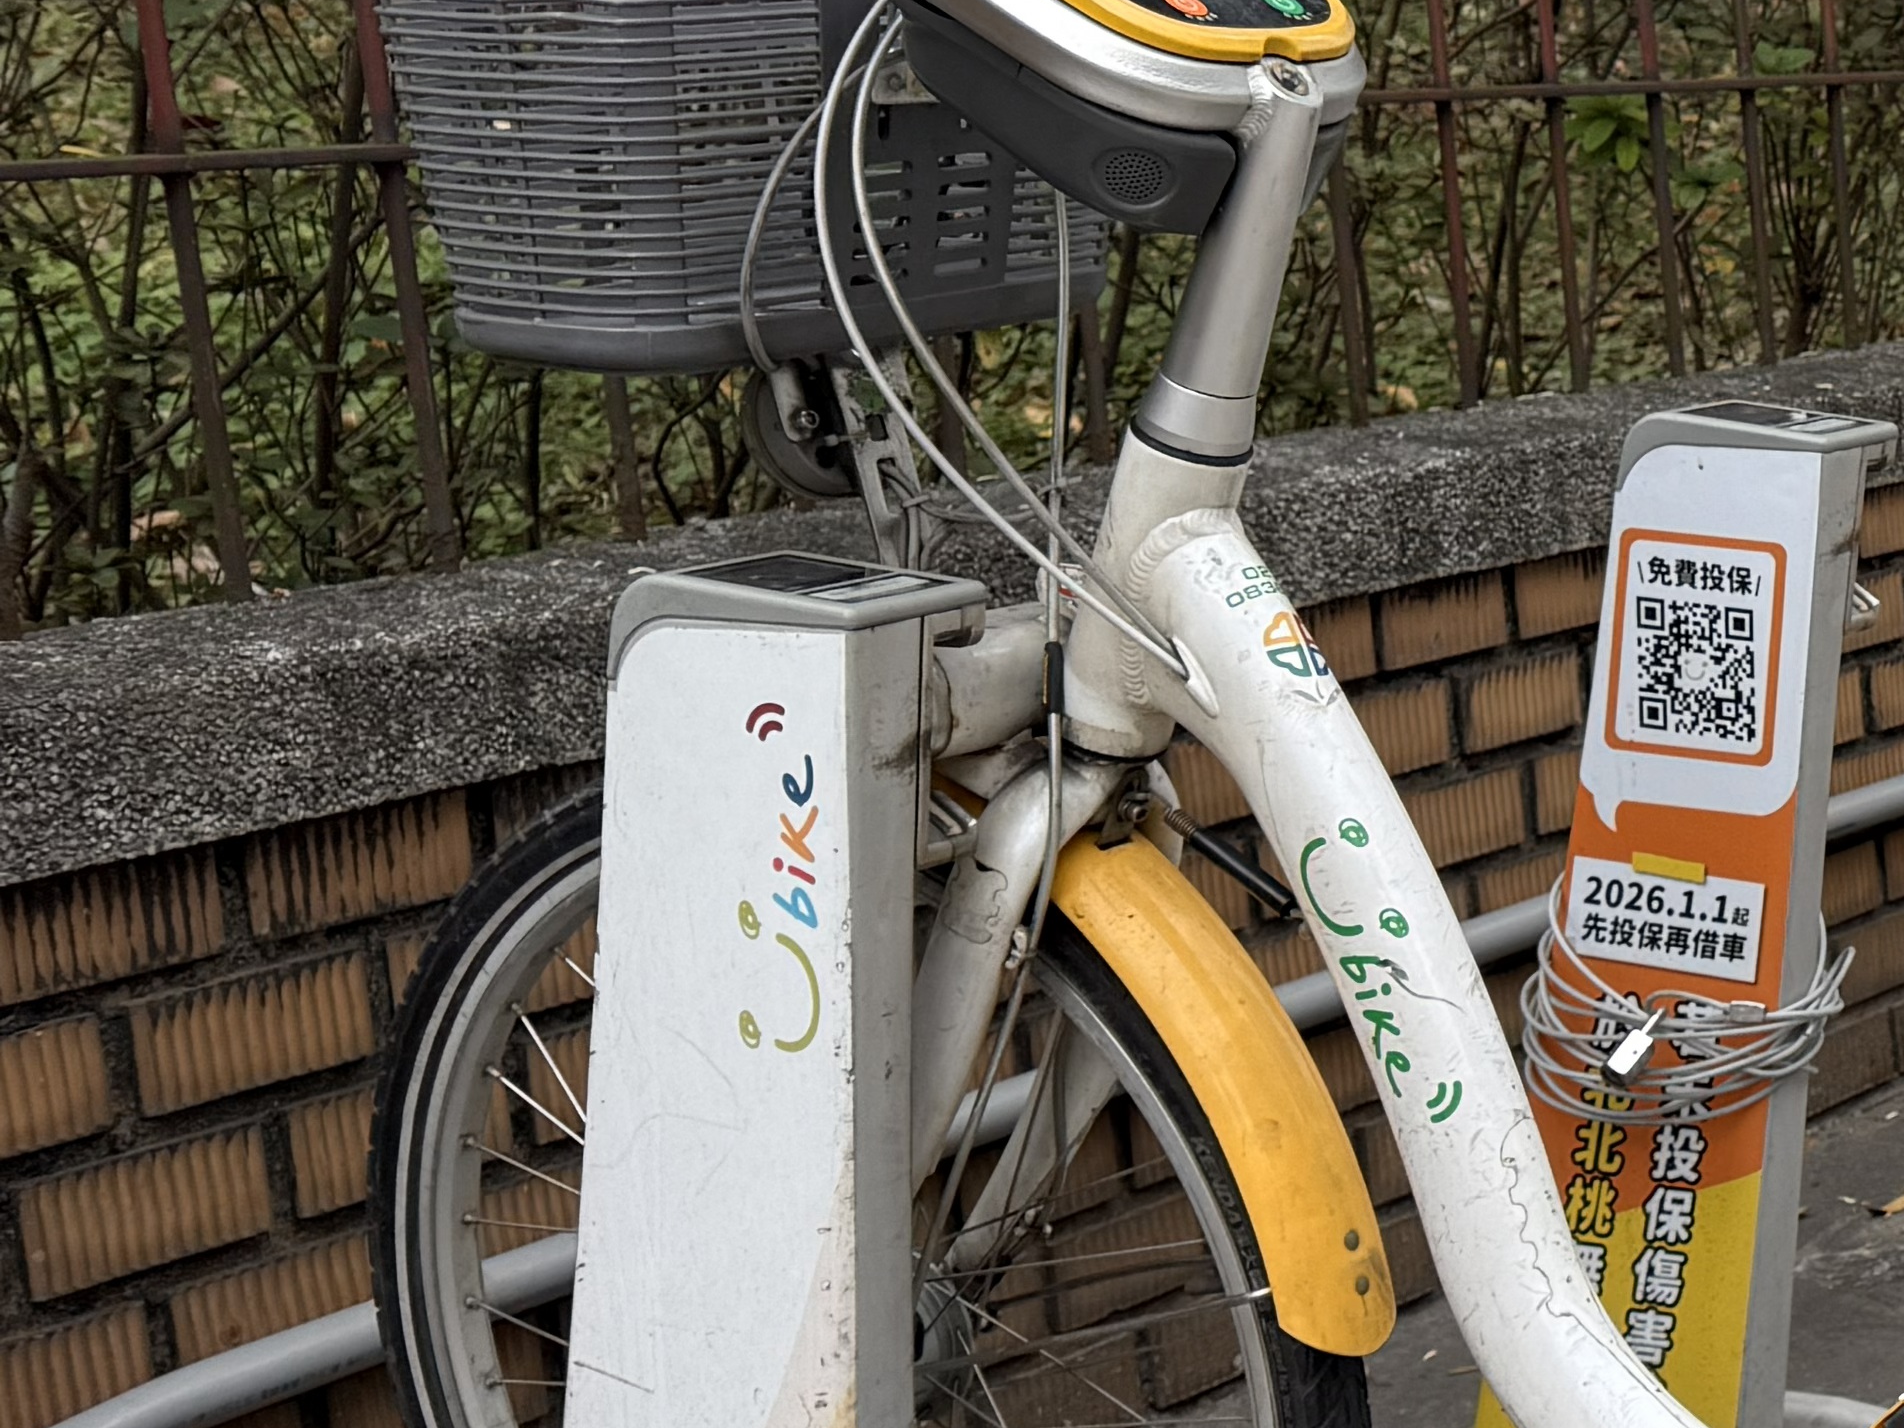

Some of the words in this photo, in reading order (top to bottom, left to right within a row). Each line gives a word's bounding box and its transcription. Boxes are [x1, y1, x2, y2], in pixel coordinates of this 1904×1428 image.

[1648, 556, 1753, 595] 免費投保
[1584, 876, 1750, 927] 2026.1.1起
[1582, 912, 1747, 963] 先投保再借車
[1626, 1000, 1724, 1368] 若未投保傷害
